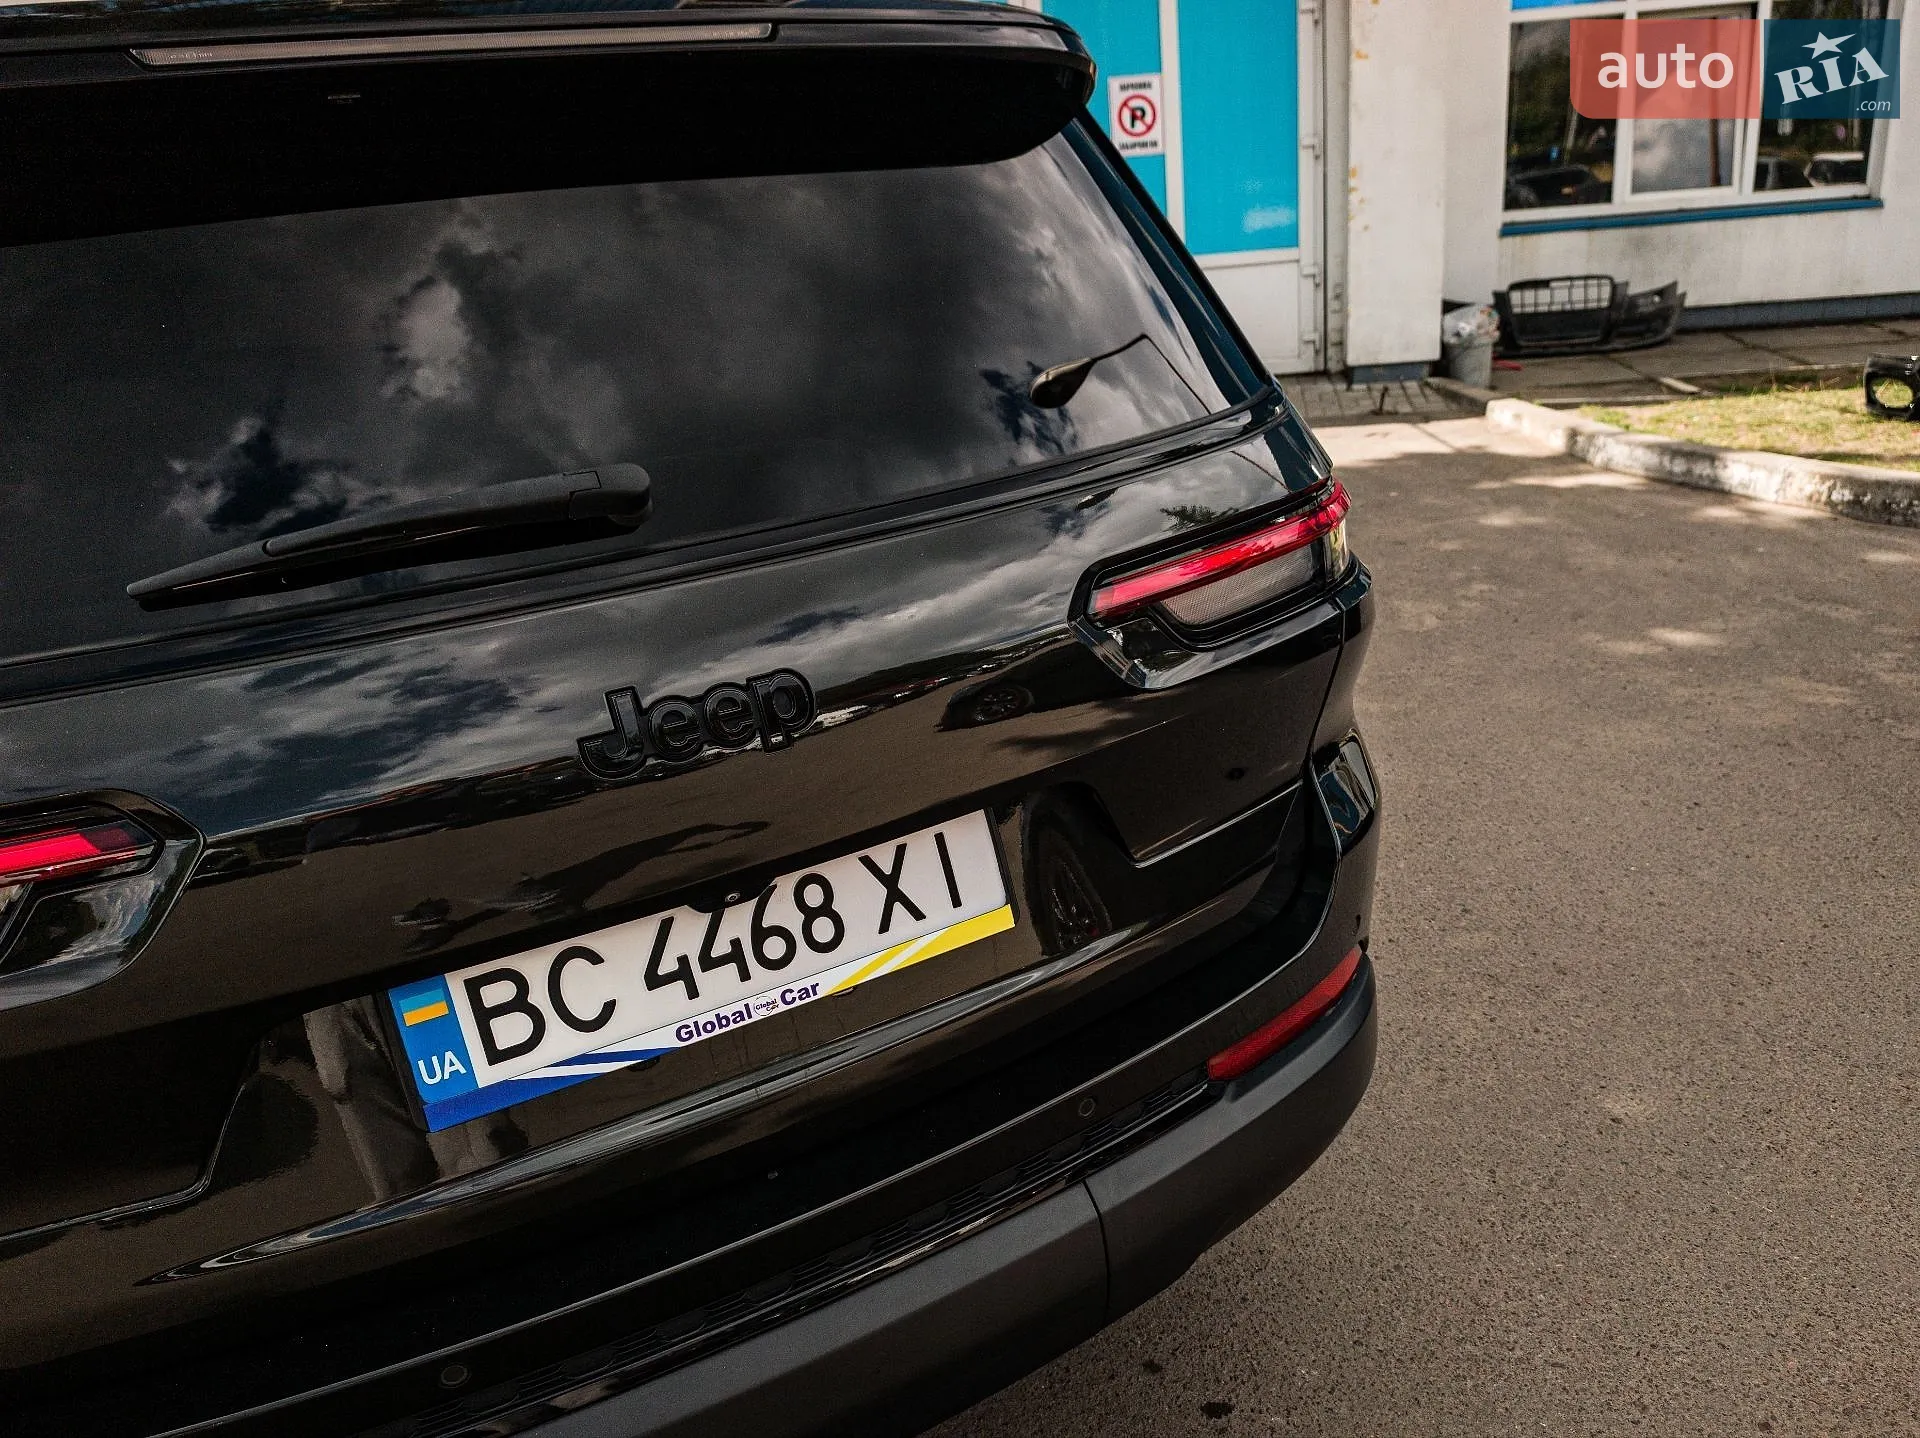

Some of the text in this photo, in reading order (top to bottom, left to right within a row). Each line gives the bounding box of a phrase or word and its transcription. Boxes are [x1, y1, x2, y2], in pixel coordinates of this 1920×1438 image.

[577, 667, 816, 780] Jeep
[463, 831, 964, 1067] BC 4468 XI
[675, 982, 820, 1043] Global Car
[416, 1051, 468, 1087] UA
